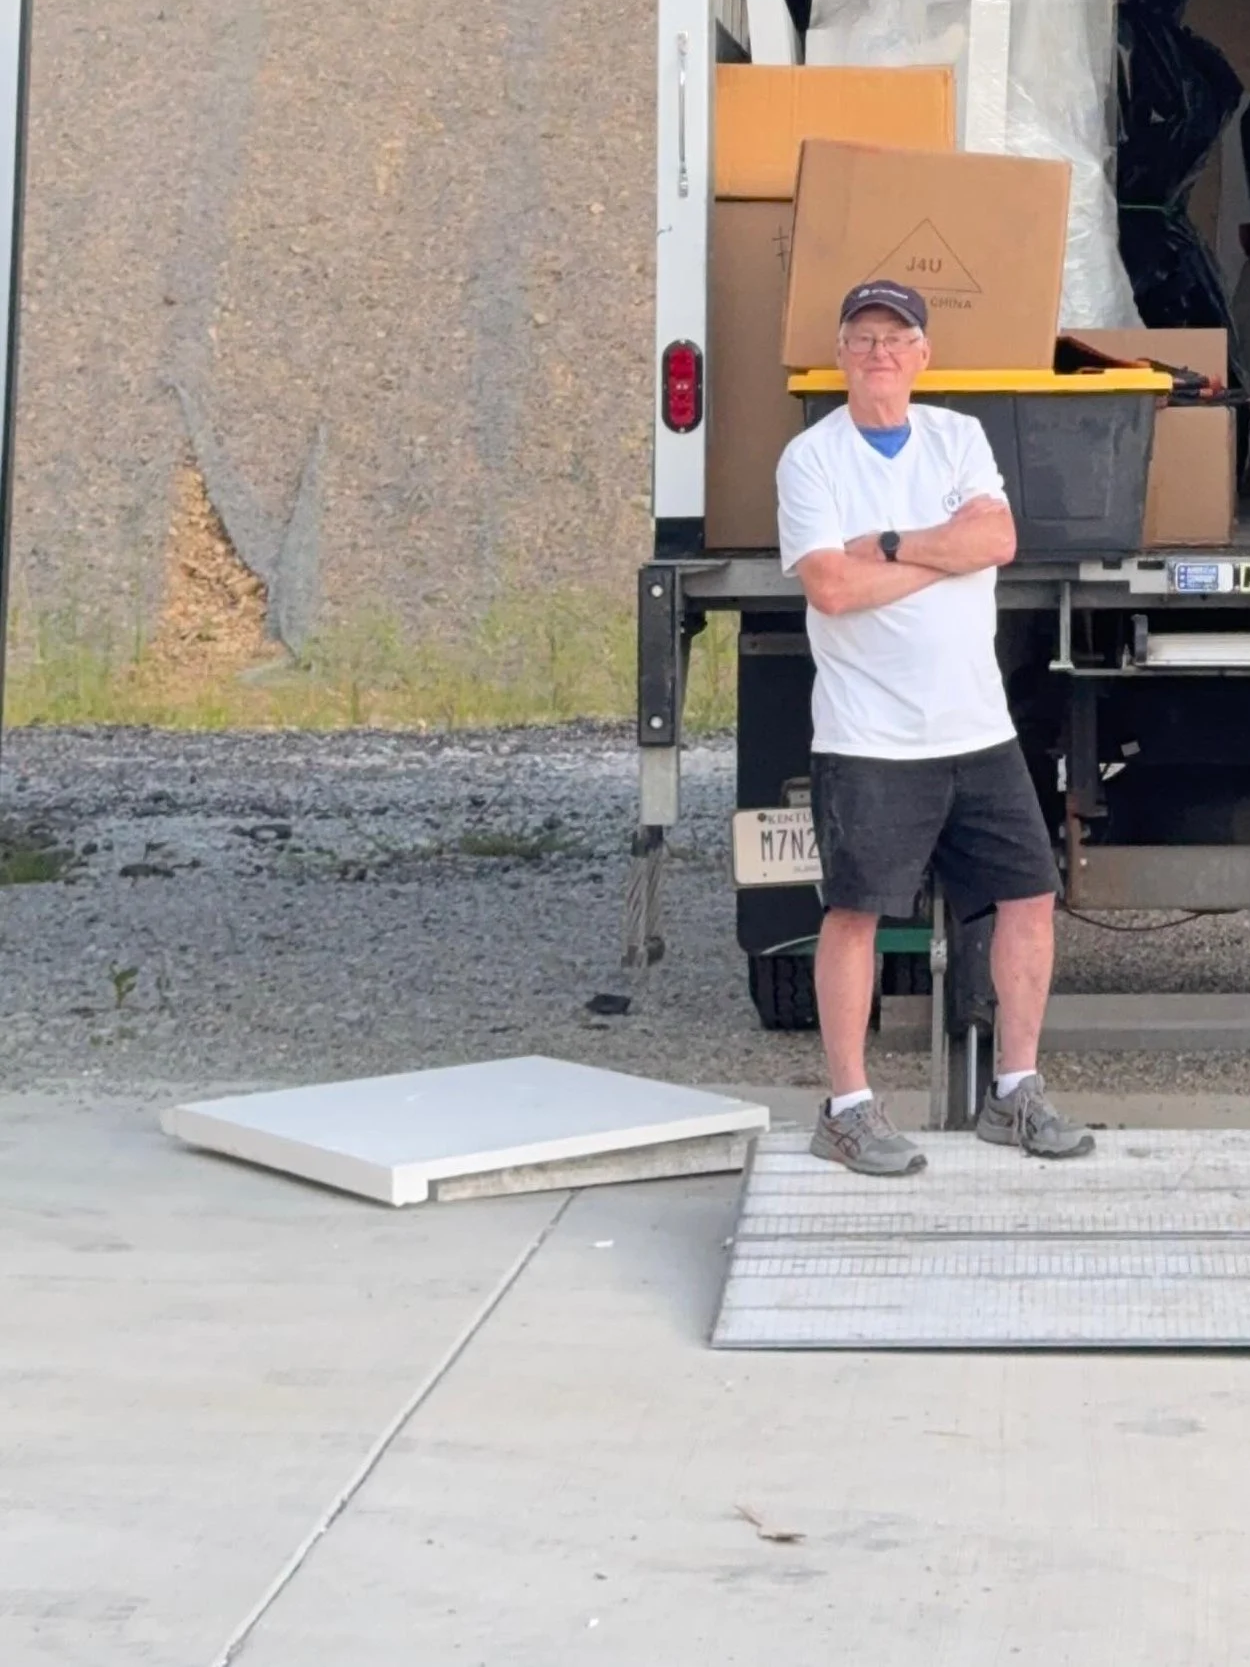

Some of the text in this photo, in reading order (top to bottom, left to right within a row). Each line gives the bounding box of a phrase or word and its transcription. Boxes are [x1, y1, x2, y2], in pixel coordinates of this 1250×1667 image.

[906, 257, 941, 273] J4U
[930, 297, 972, 309] CHINA
[768, 813, 812, 824] KENTU
[761, 827, 819, 862] M7N2
